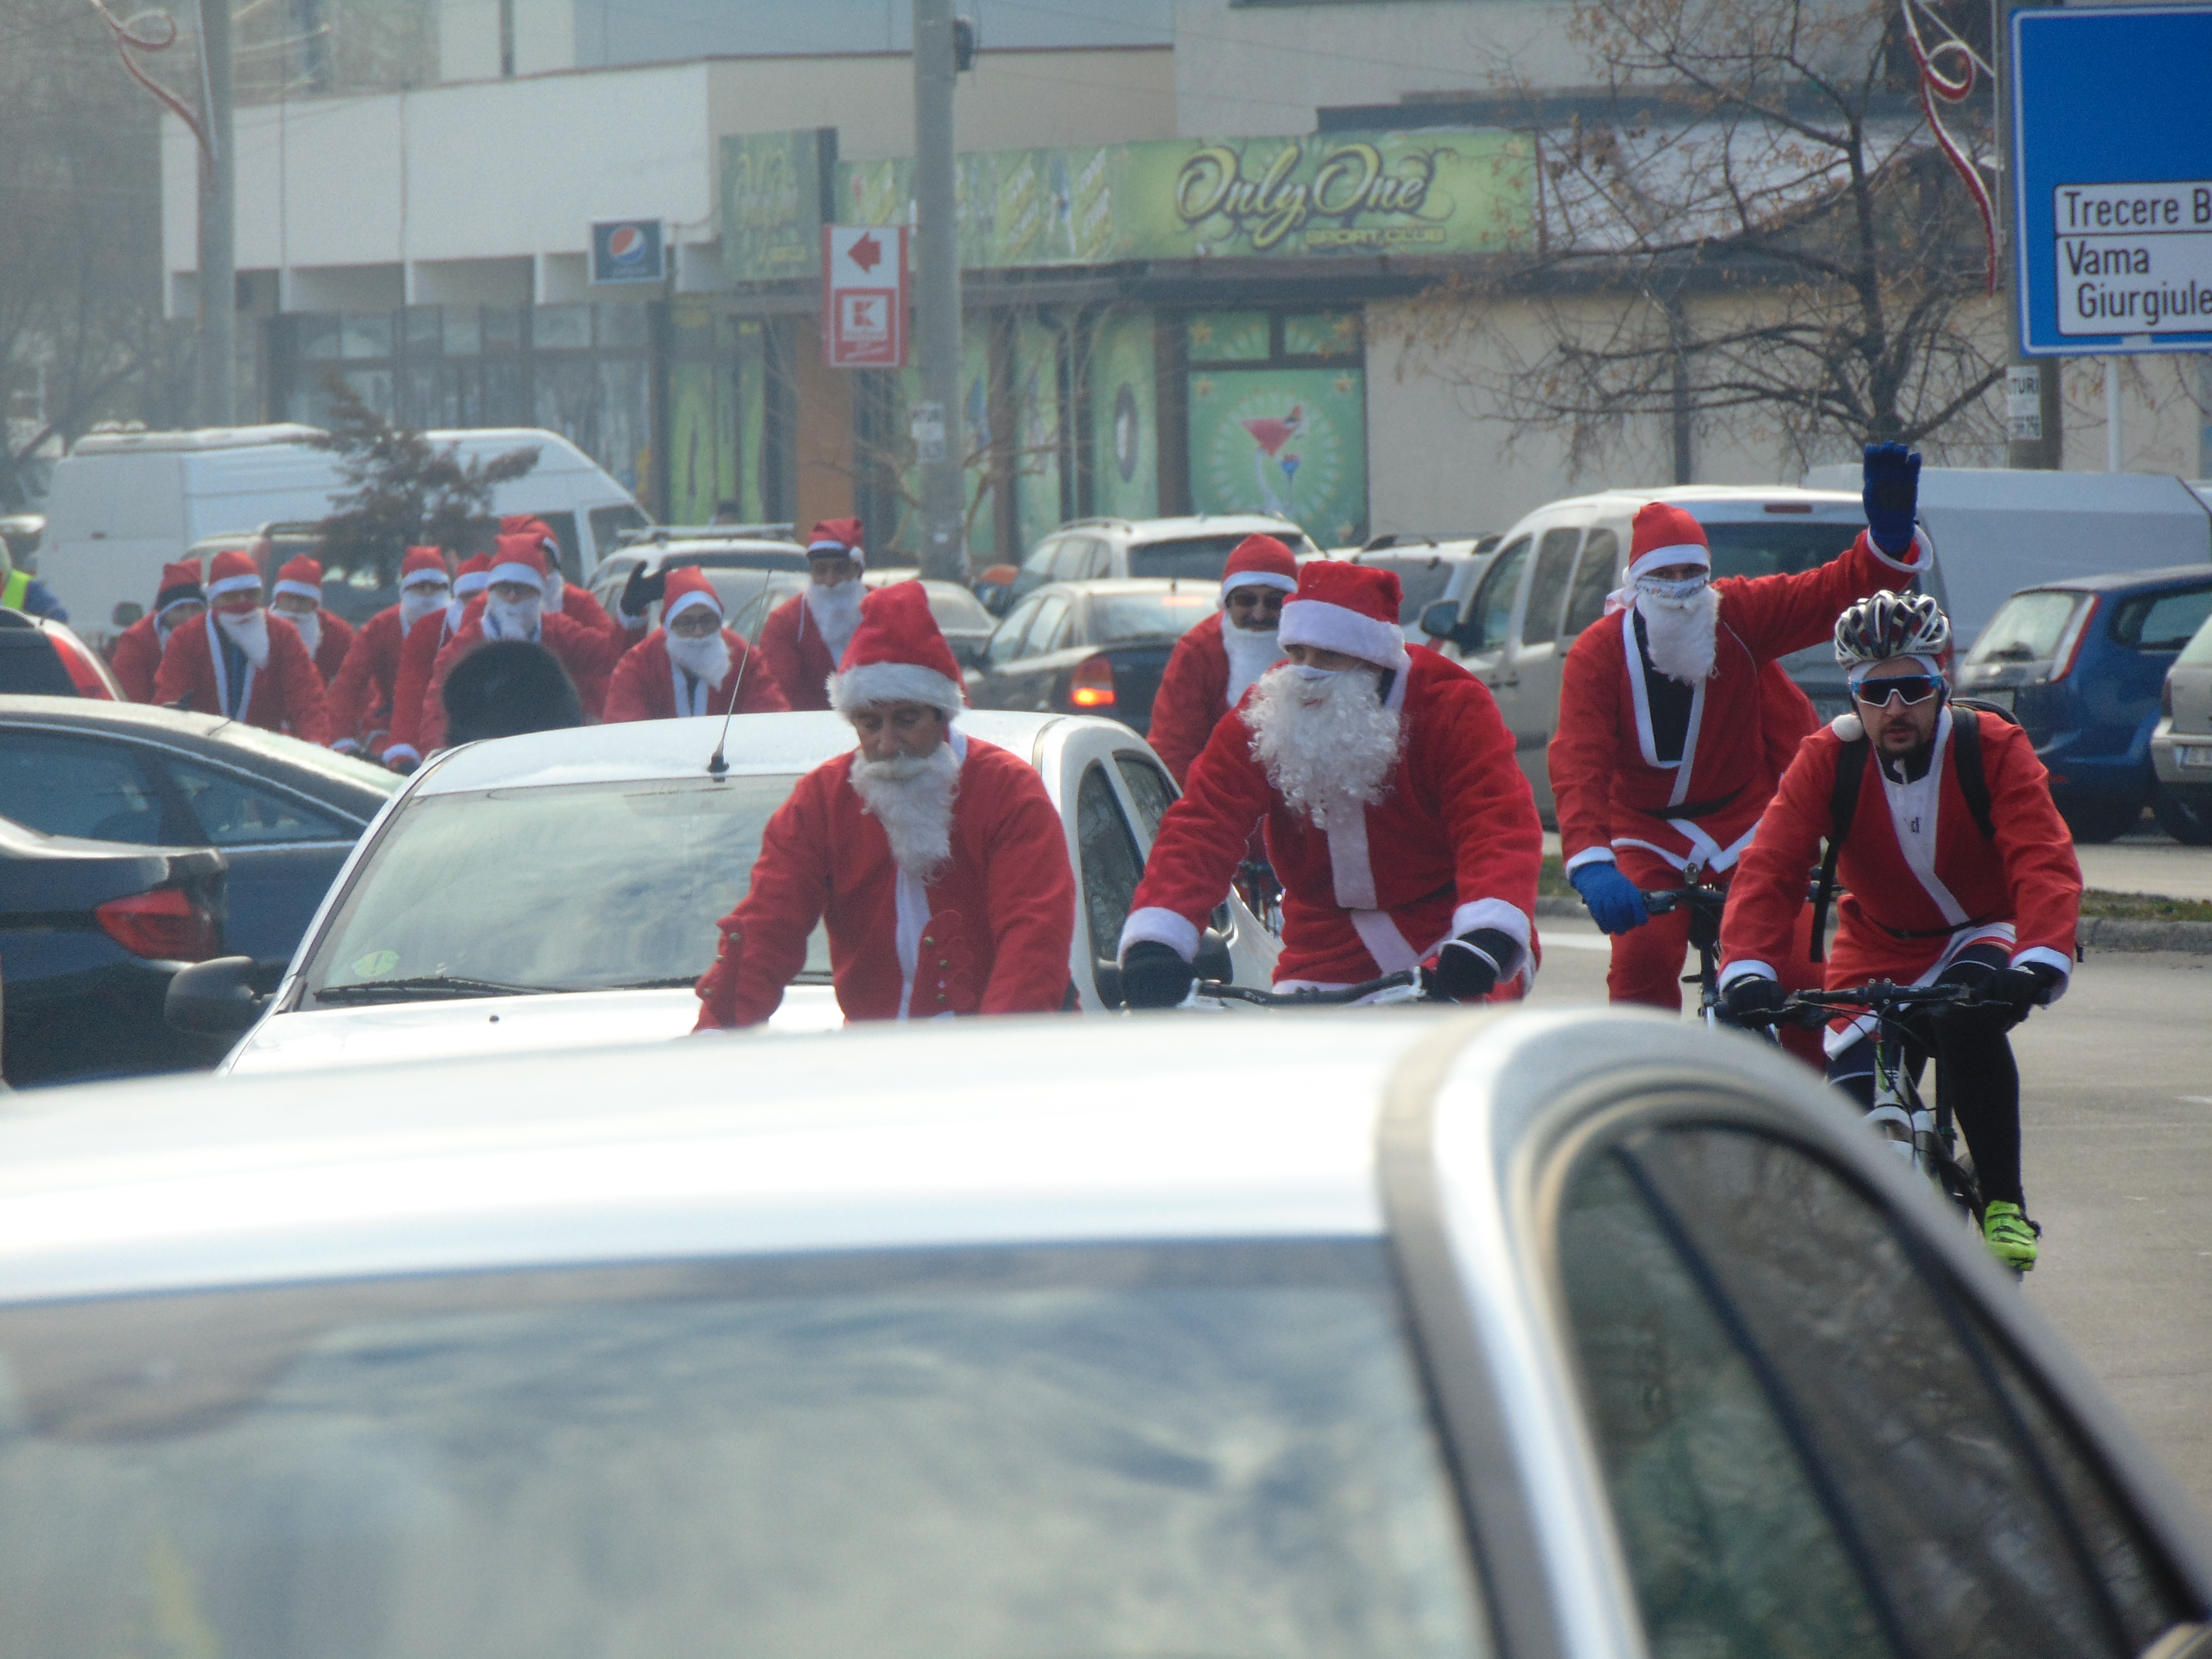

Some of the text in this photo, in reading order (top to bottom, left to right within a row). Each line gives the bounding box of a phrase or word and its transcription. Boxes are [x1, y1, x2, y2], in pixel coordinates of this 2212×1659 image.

[1176, 142, 1425, 248] Only One
[2063, 191, 2179, 227] Trecere
[2065, 240, 2150, 276] Vama
[2077, 280, 2212, 326] Giurgiule
